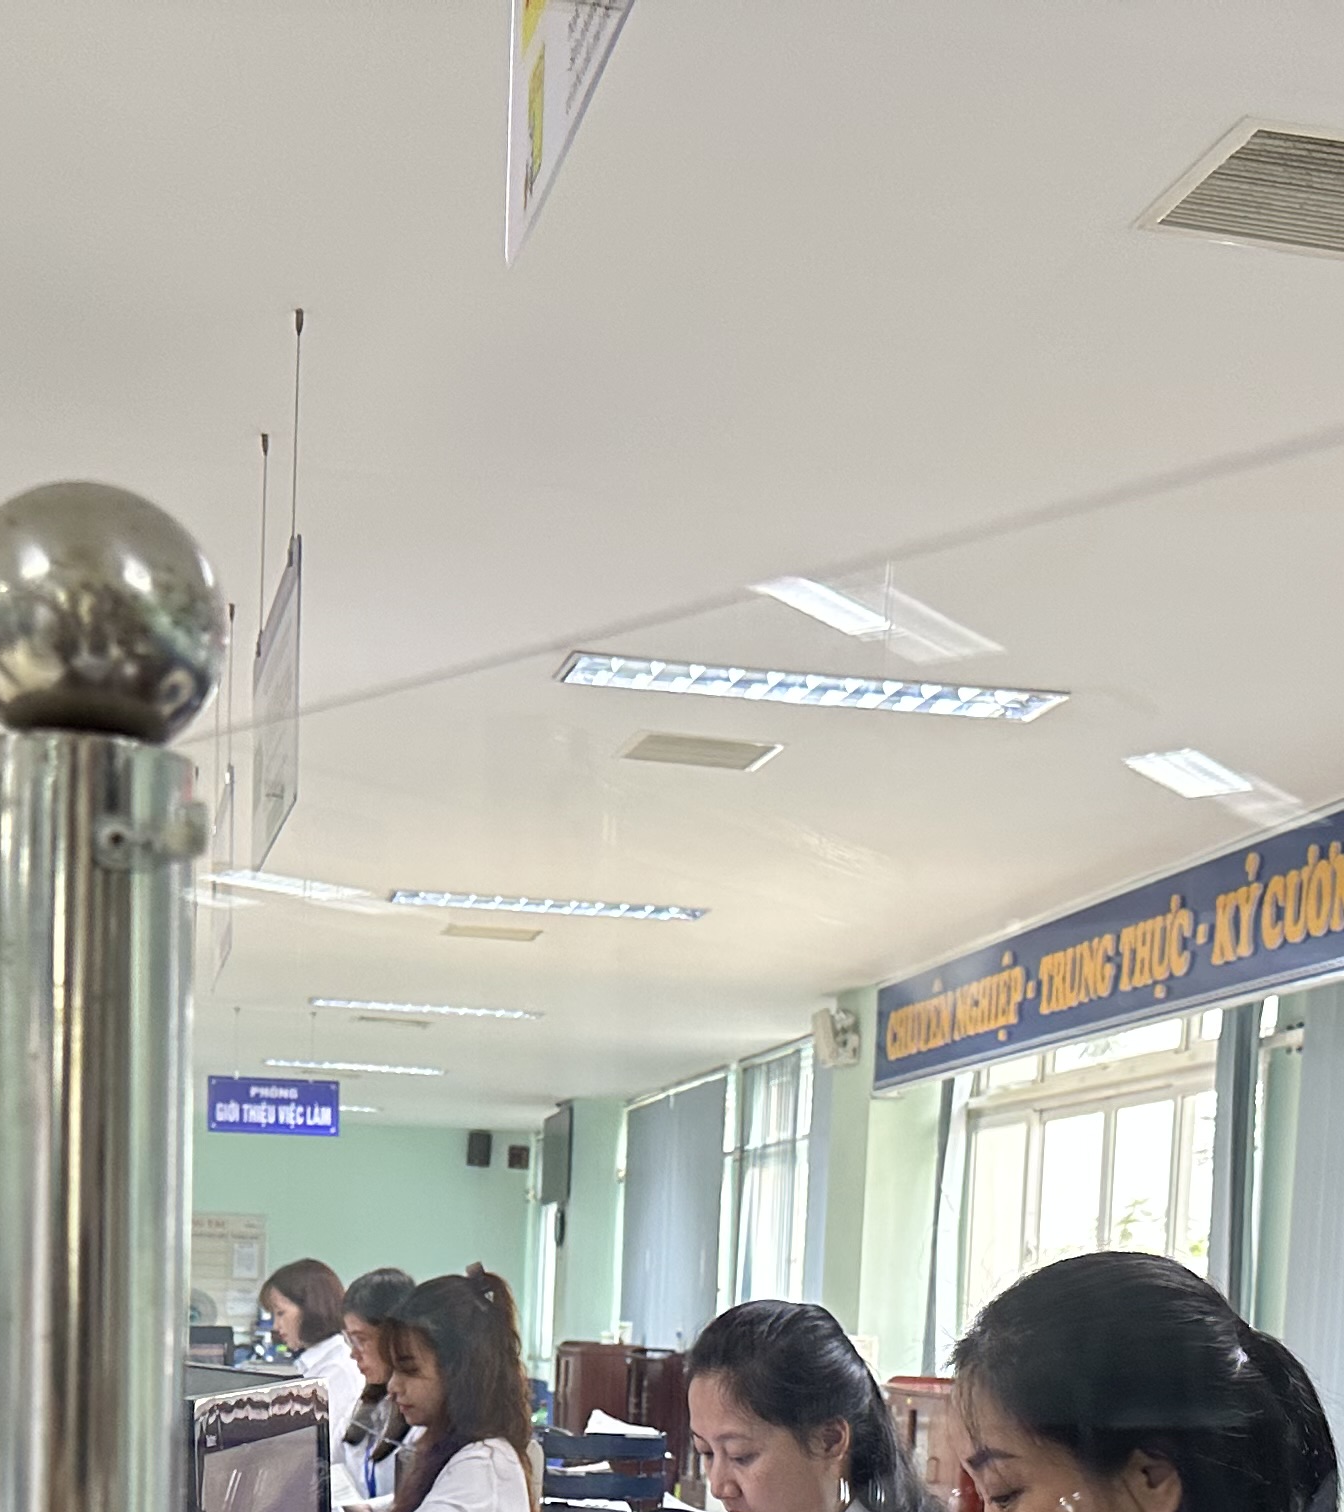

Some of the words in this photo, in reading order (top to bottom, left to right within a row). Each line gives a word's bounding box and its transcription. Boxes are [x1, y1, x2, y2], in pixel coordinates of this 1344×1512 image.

[887, 978, 953, 1061] CHUYÊN
[953, 950, 1026, 1041] NGHIỆP
[1038, 934, 1116, 1015] TRUNG
[1119, 894, 1193, 999] THỰC
[1211, 852, 1264, 966] KỶ
[215, 1100, 240, 1122] GIỚI
[242, 1101, 276, 1127] THIỆU
[278, 1102, 305, 1129] VIỆC
[306, 1101, 332, 1126] LÀM
